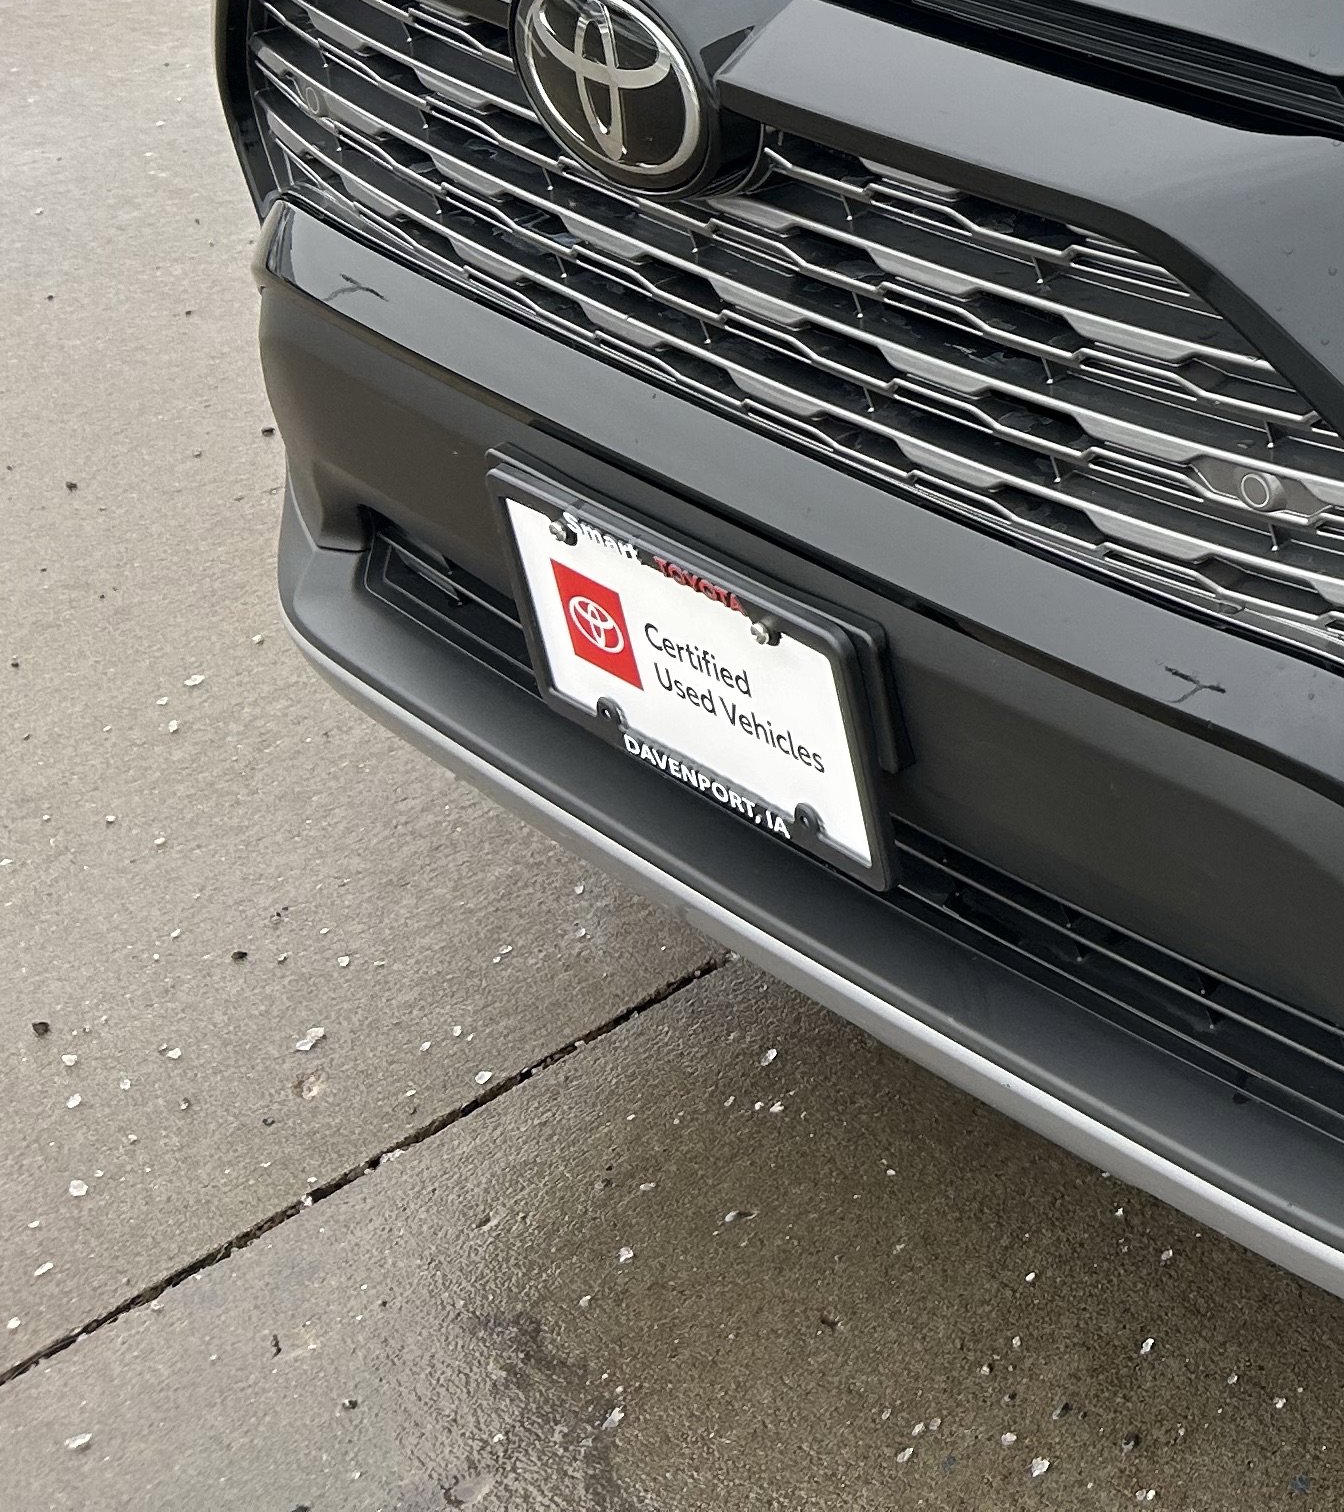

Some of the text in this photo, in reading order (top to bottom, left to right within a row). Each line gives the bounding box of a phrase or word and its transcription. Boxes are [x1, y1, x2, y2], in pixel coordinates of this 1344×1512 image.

[562, 511, 748, 617] Smart TOYOTA
[644, 622, 752, 698] Certified
[653, 662, 825, 774] Used Vehicles
[623, 733, 791, 840] DAVENPORT, IA
